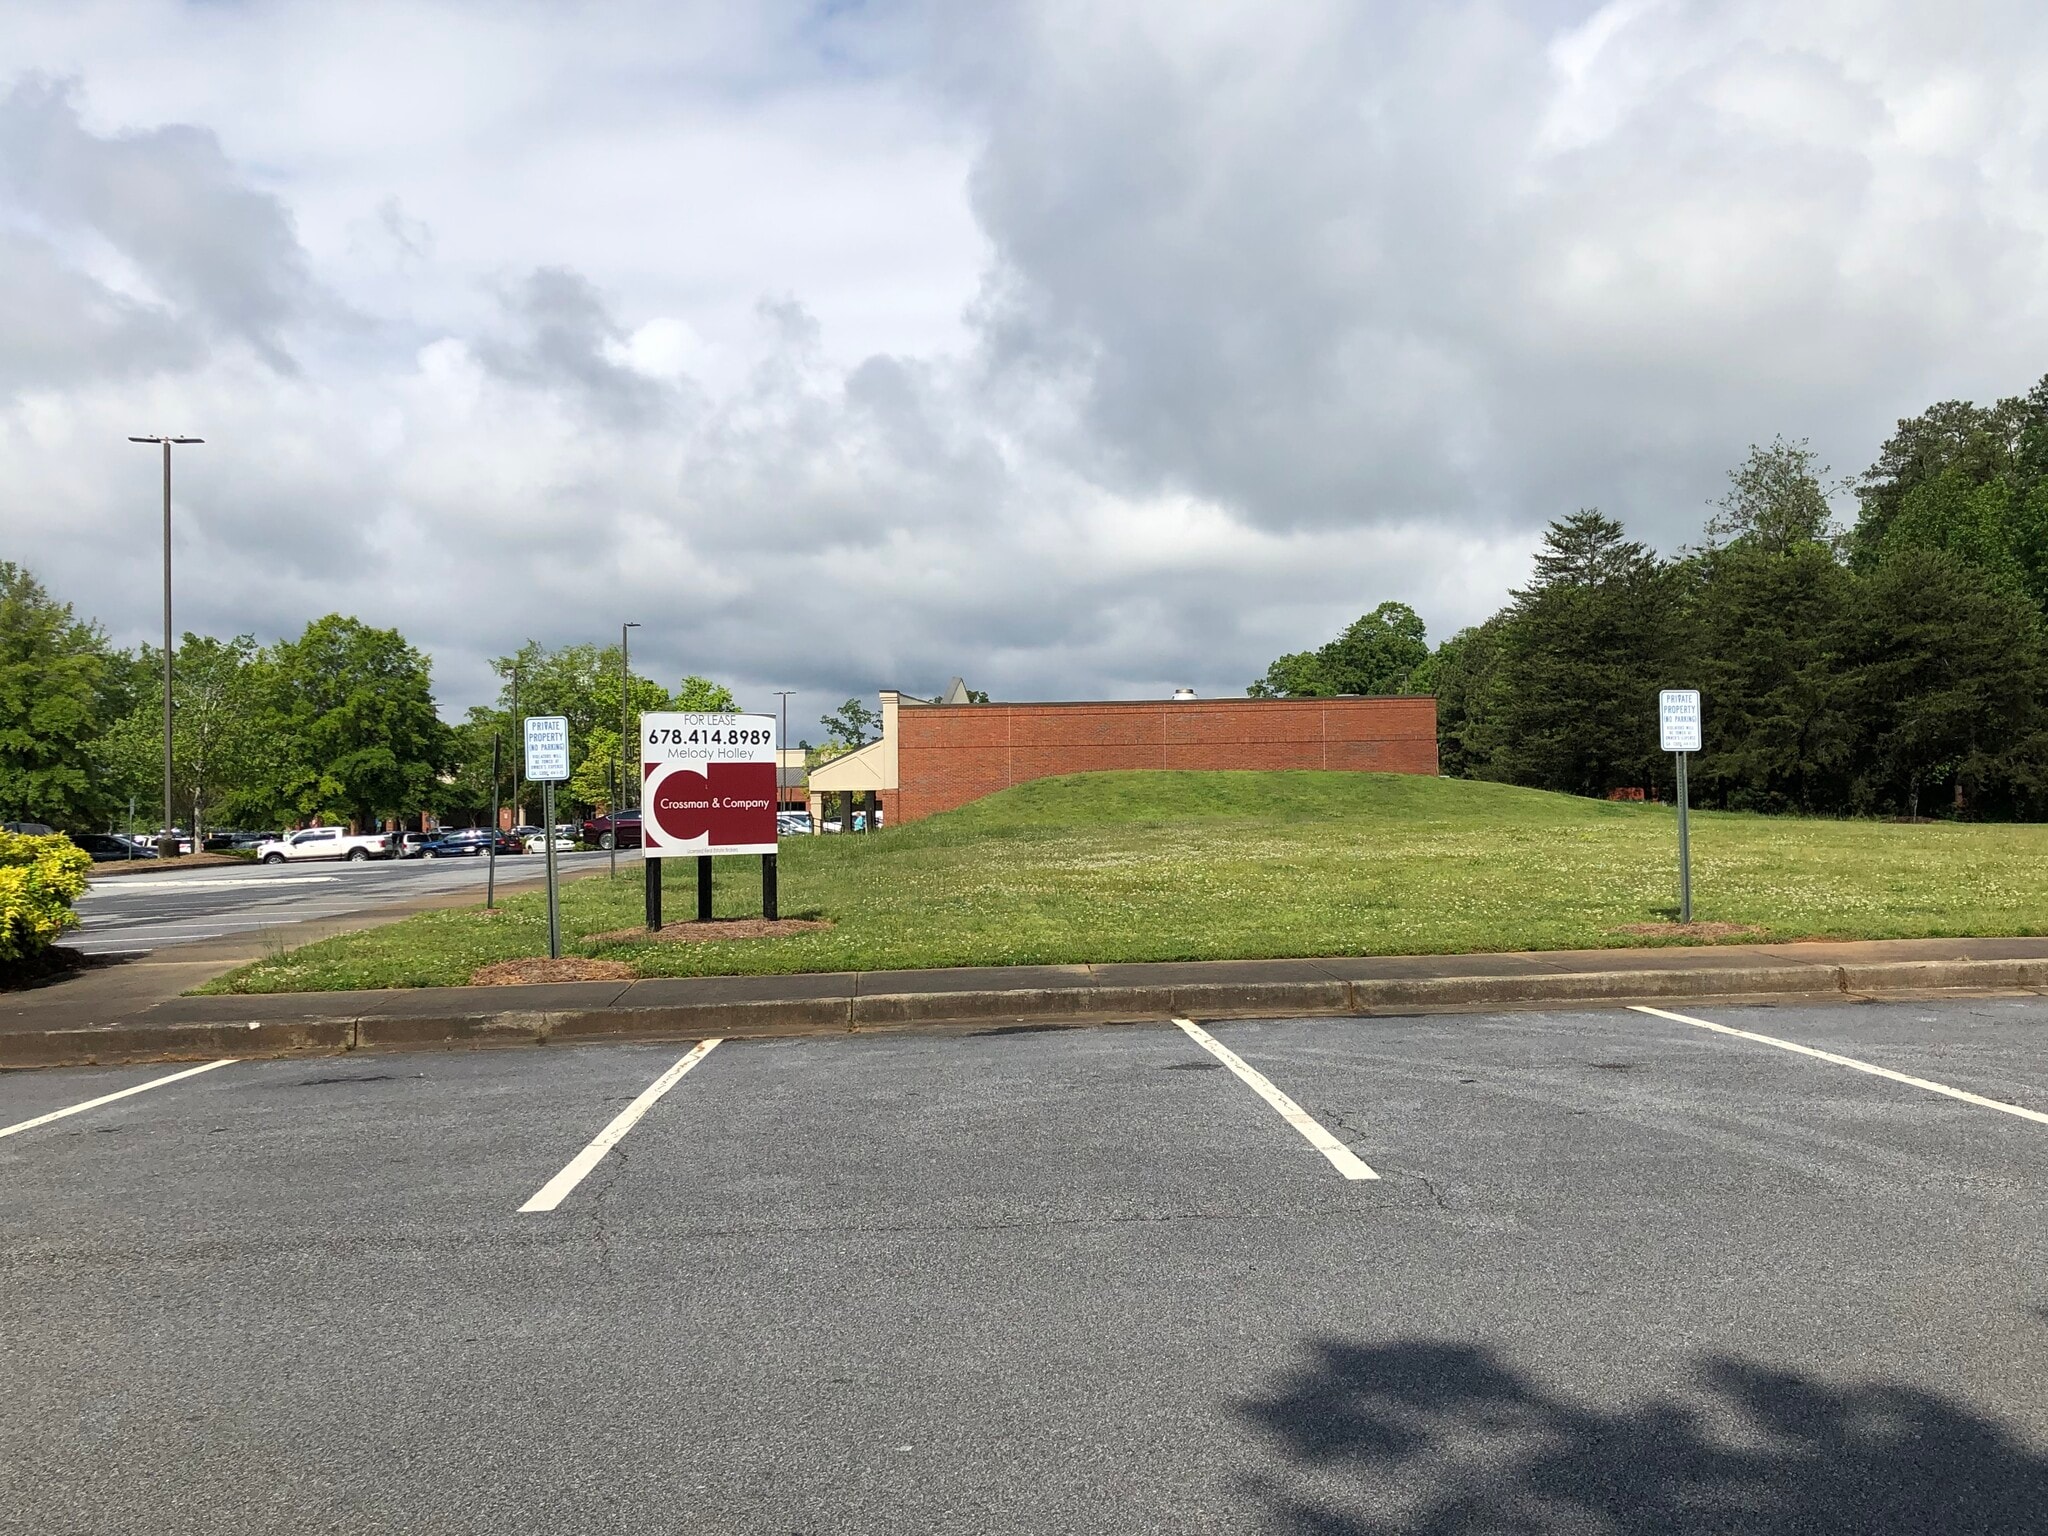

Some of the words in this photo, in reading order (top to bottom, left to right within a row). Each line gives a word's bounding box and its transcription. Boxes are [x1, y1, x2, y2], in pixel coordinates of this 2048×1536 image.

[1666, 694, 1692, 703] PRIVATE
[1664, 706, 1696, 714] PROPERTY
[532, 721, 560, 730] PRIVATE
[684, 714, 704, 726] FOR
[708, 715, 736, 726] LEASE
[529, 732, 564, 742] PROPERTY
[648, 730, 771, 745] 678.414.8989
[668, 748, 714, 760] Melody
[718, 748, 754, 760] Holley
[660, 798, 708, 809] Crossman
[712, 798, 720, 808] &
[723, 797, 770, 810] Company
